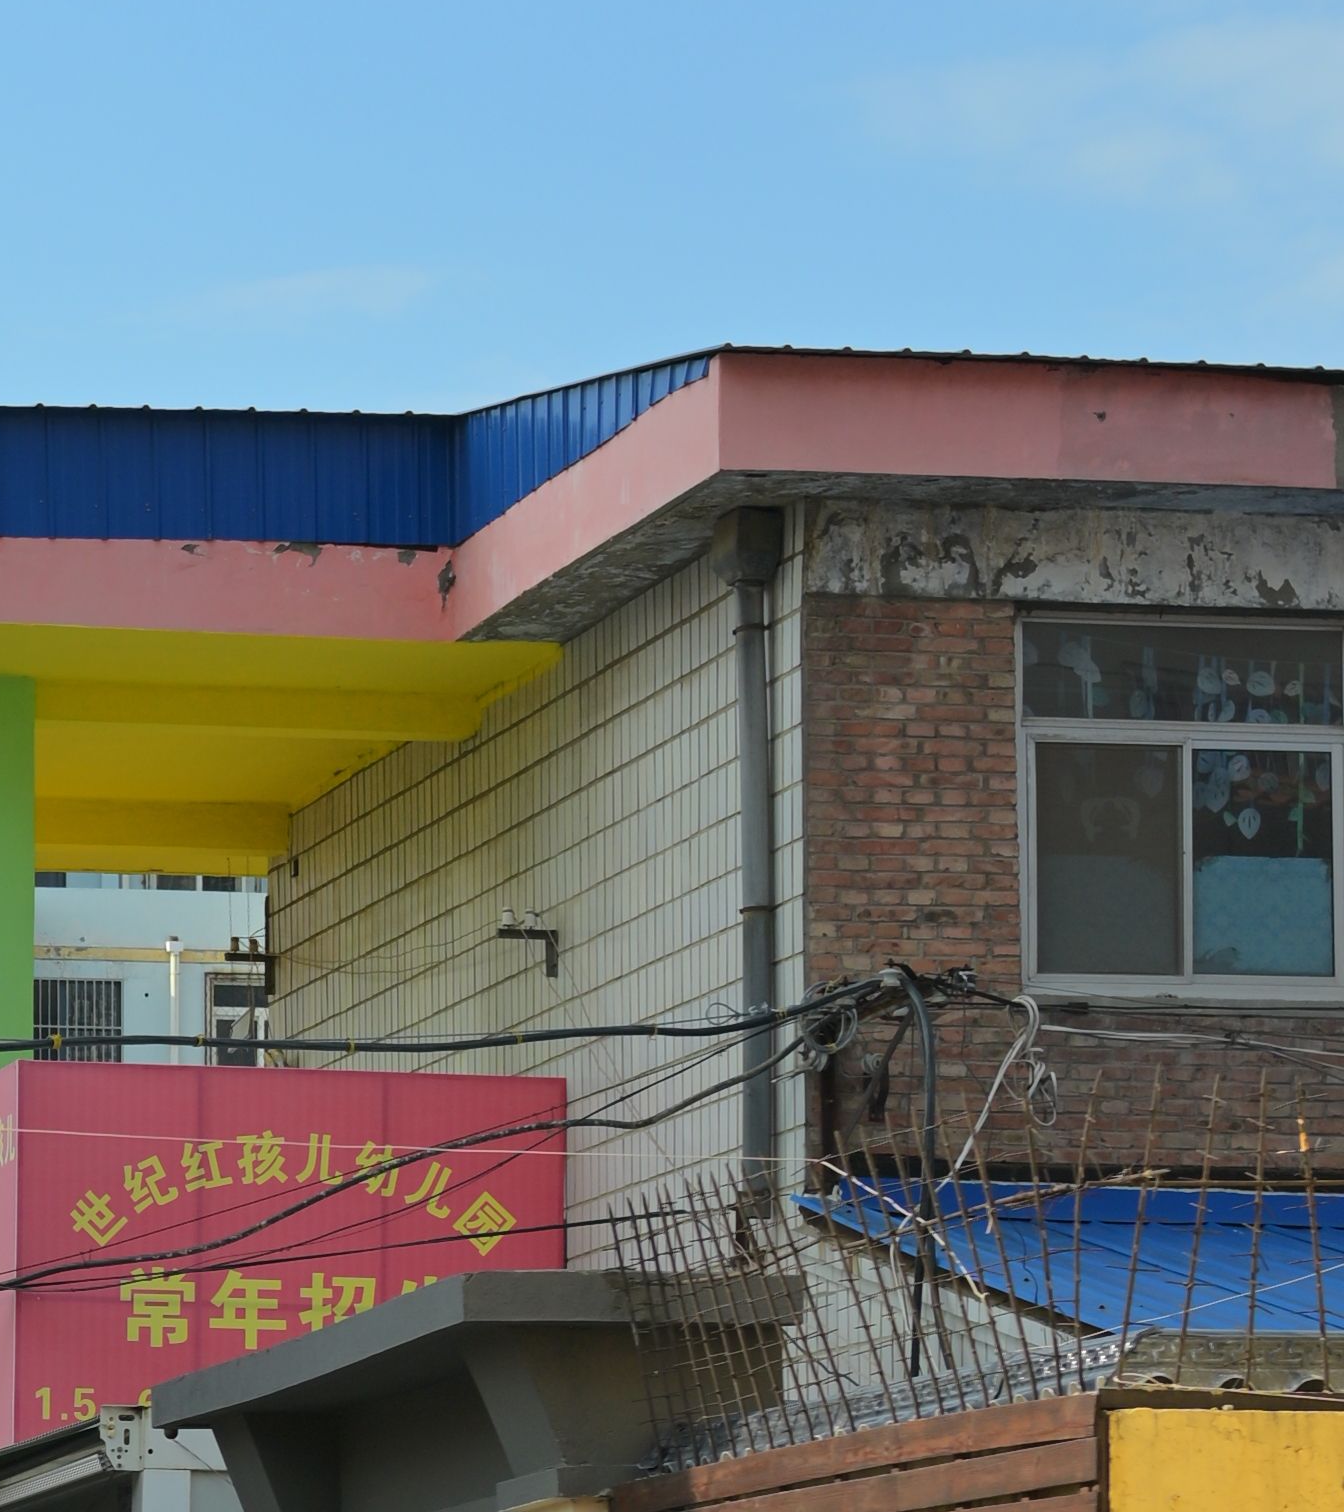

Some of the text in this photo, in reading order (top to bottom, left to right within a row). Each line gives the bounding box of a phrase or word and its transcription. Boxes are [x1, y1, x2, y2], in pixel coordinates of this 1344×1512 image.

[69, 1129, 518, 1257] 世纪红孩儿幼儿园
[120, 1266, 438, 1350] 常年招
